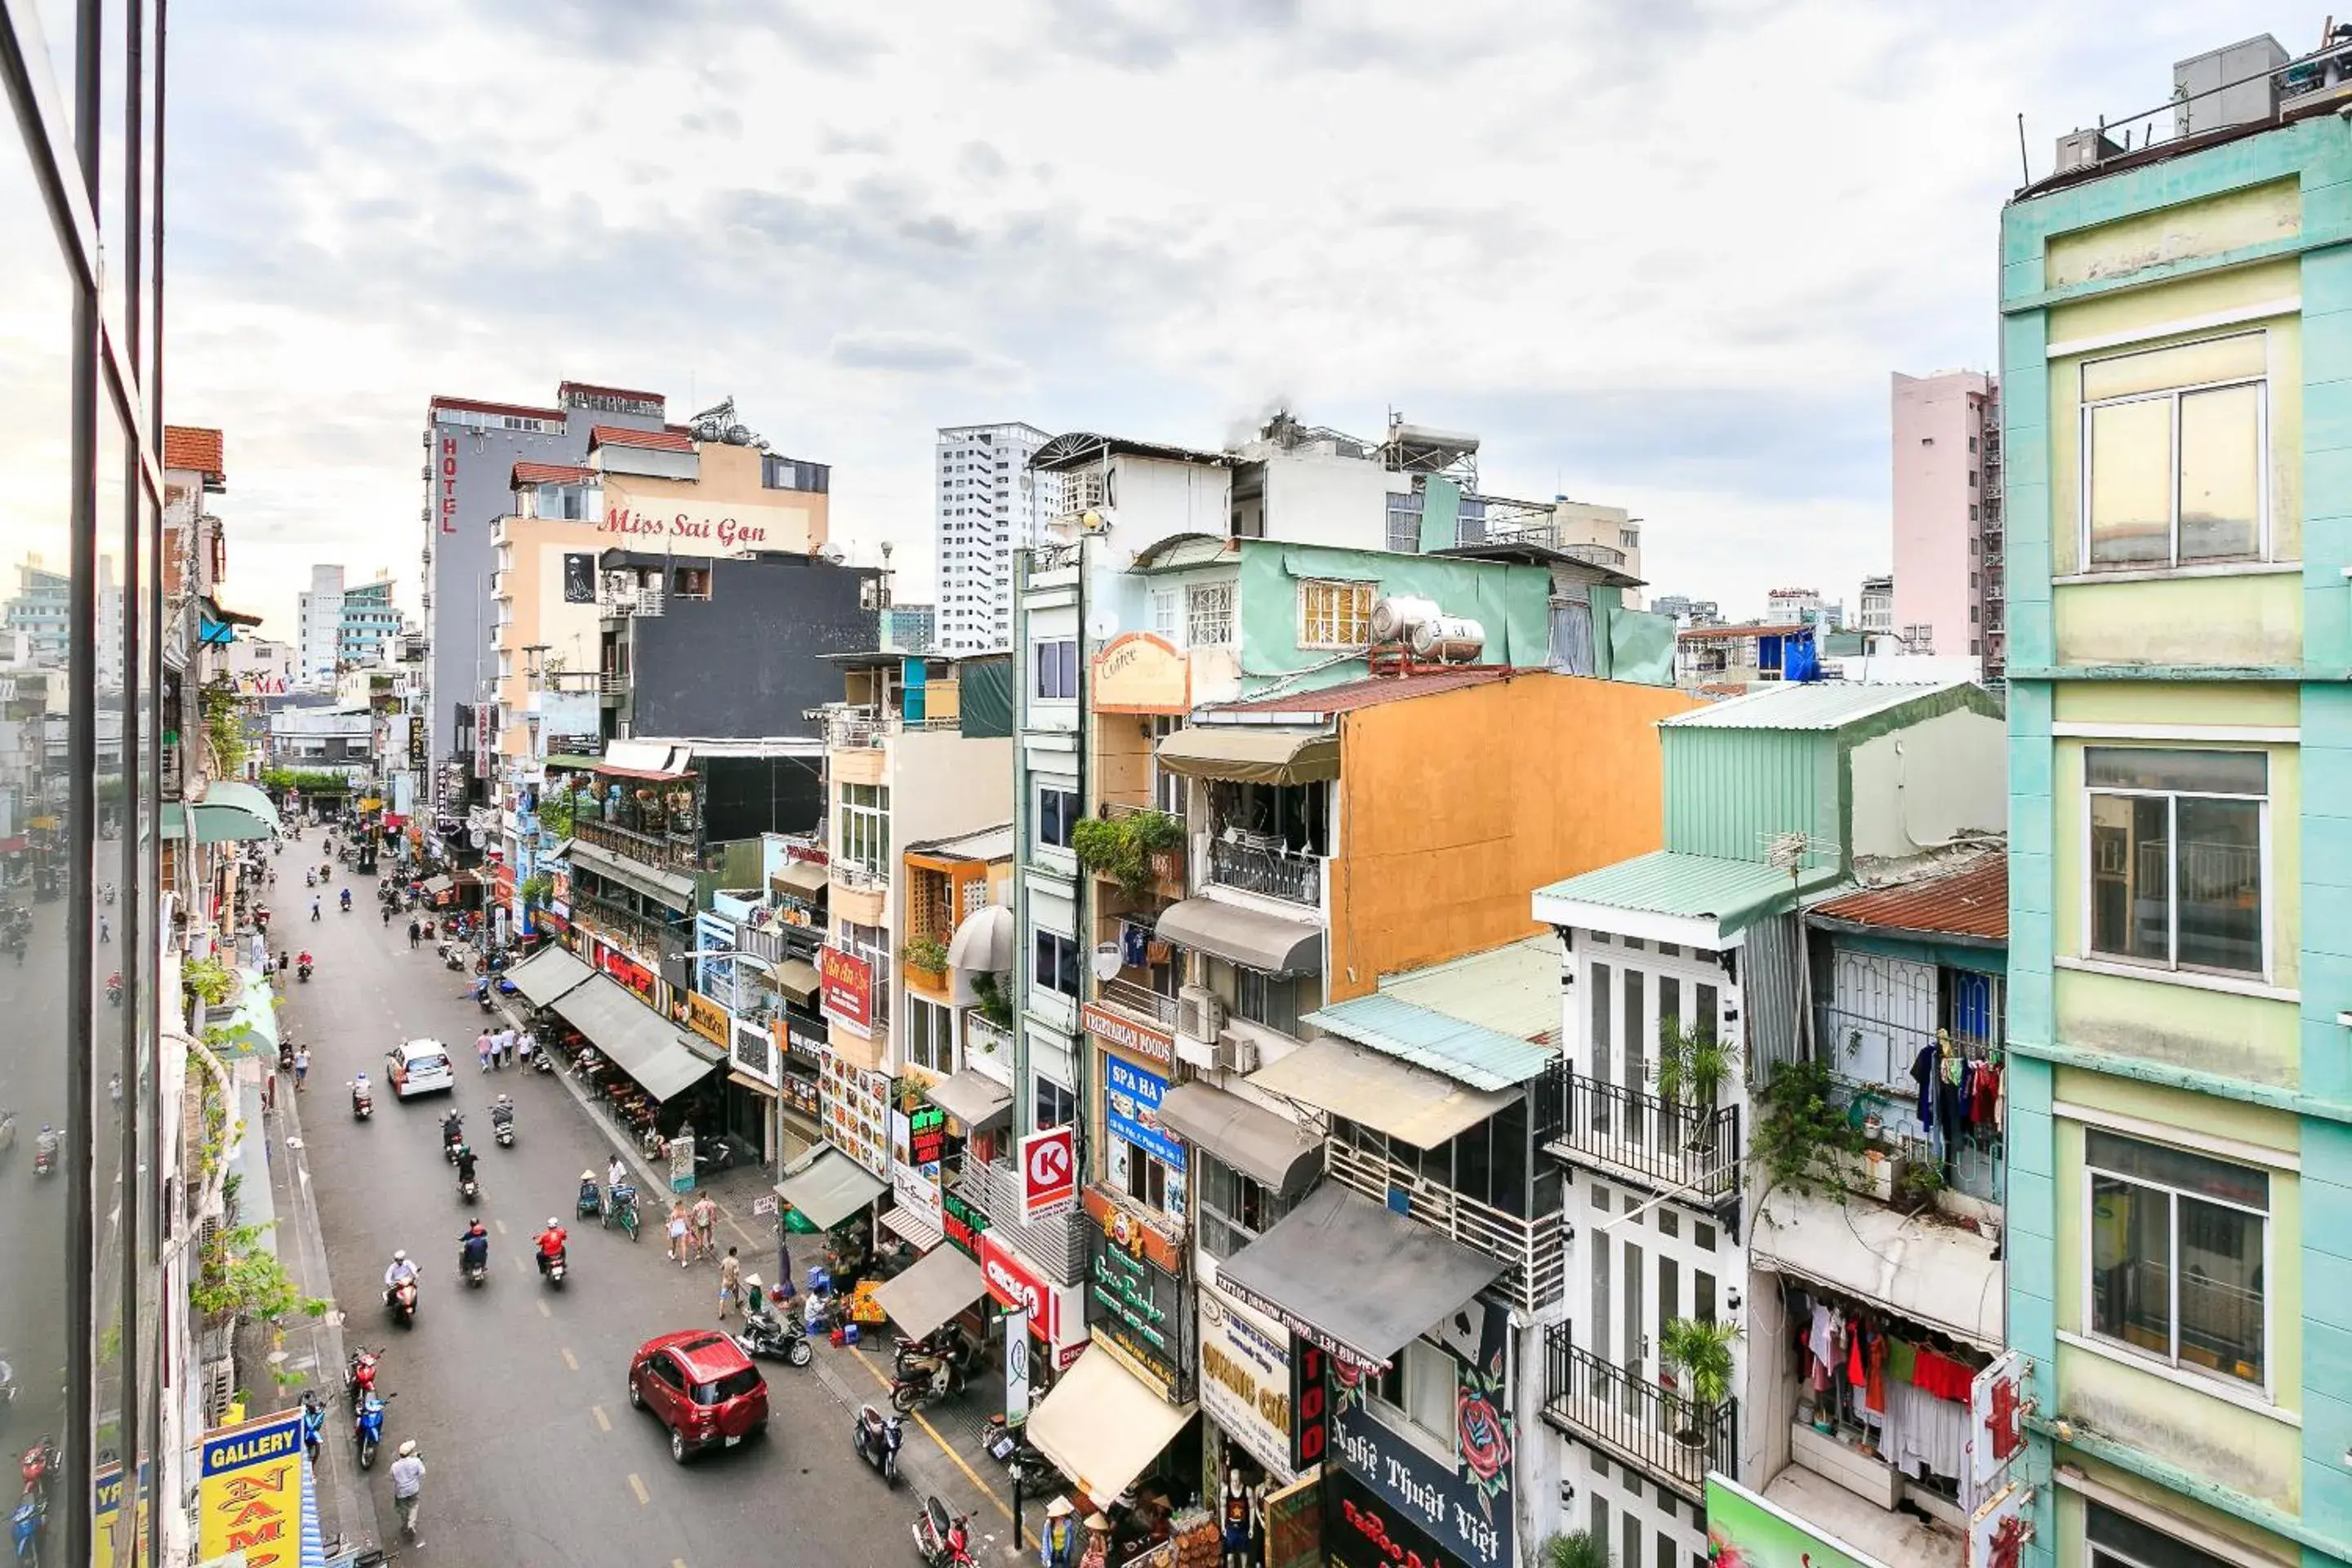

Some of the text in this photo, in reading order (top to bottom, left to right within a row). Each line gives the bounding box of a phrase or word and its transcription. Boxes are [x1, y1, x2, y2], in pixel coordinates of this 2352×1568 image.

[443, 438, 457, 532] HOTEL
[597, 508, 766, 546] Miss Sai Gon
[1085, 1011, 1171, 1062] VEGETARIAN FOODS
[1112, 1065, 1136, 1091] SPA
[987, 1259, 1025, 1304] CIRCLE
[1247, 1292, 1281, 1322] DRAGON
[1319, 1334, 1336, 1352] 134
[211, 1428, 296, 1469] GALLERY
[1385, 1455, 1446, 1524] Thuật
[1453, 1501, 1500, 1563] Việt
